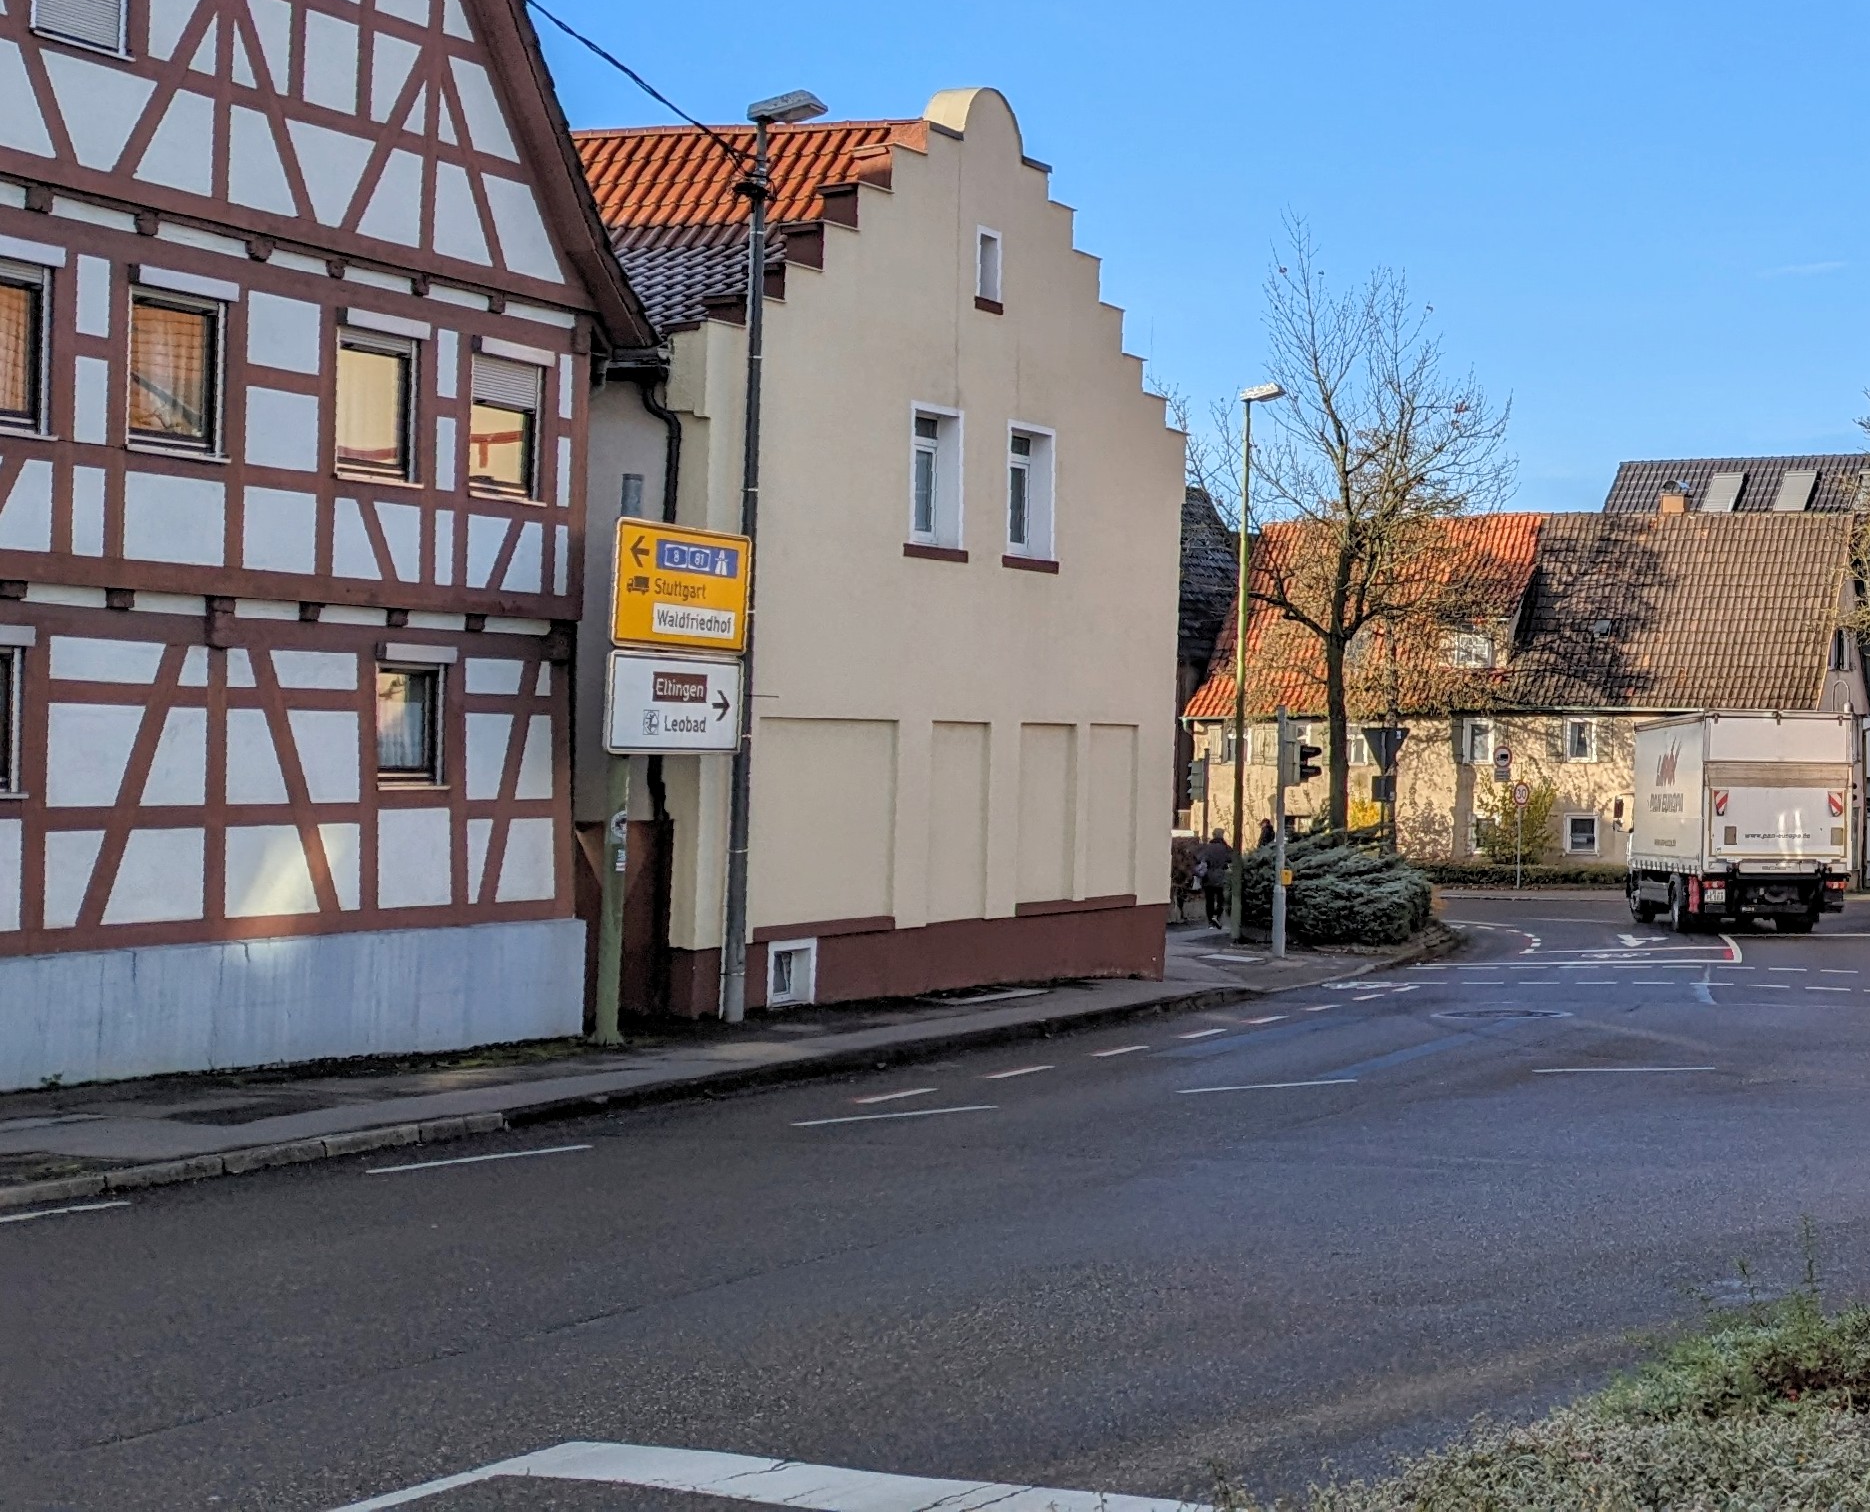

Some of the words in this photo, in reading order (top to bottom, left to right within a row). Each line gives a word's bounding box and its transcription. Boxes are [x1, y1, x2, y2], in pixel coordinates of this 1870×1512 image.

[673, 550, 680, 563] 8
[694, 553, 705, 566] 81
[654, 577, 707, 601] Stuttgart
[657, 608, 733, 634] Waldfriedhof
[655, 678, 704, 701] Eltingen
[664, 715, 707, 733] Leobad
[1516, 788, 1527, 800] 30
